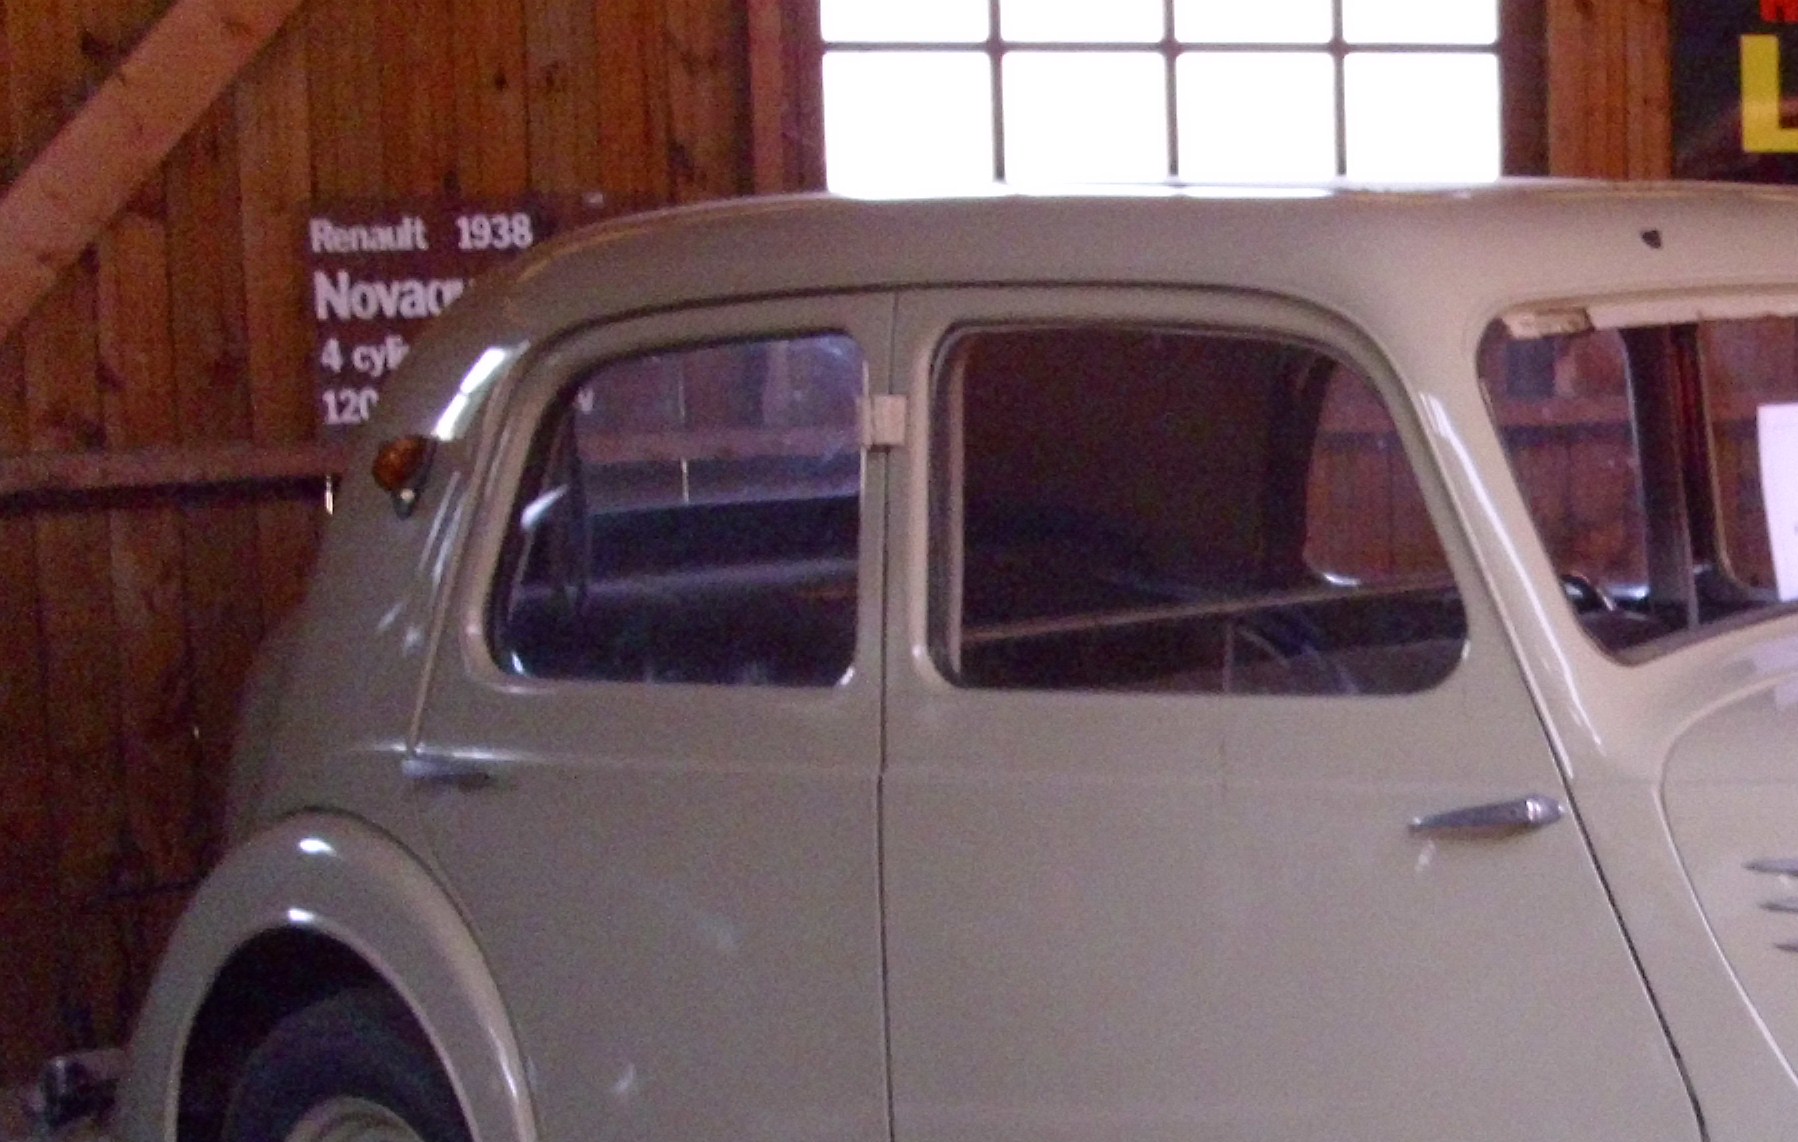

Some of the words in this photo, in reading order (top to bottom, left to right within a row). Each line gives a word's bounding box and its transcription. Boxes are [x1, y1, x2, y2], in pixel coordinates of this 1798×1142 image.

[309, 215, 429, 252] Renault
[457, 212, 534, 250] 1938
[313, 269, 475, 320] Novaq
[321, 336, 344, 374] 4
